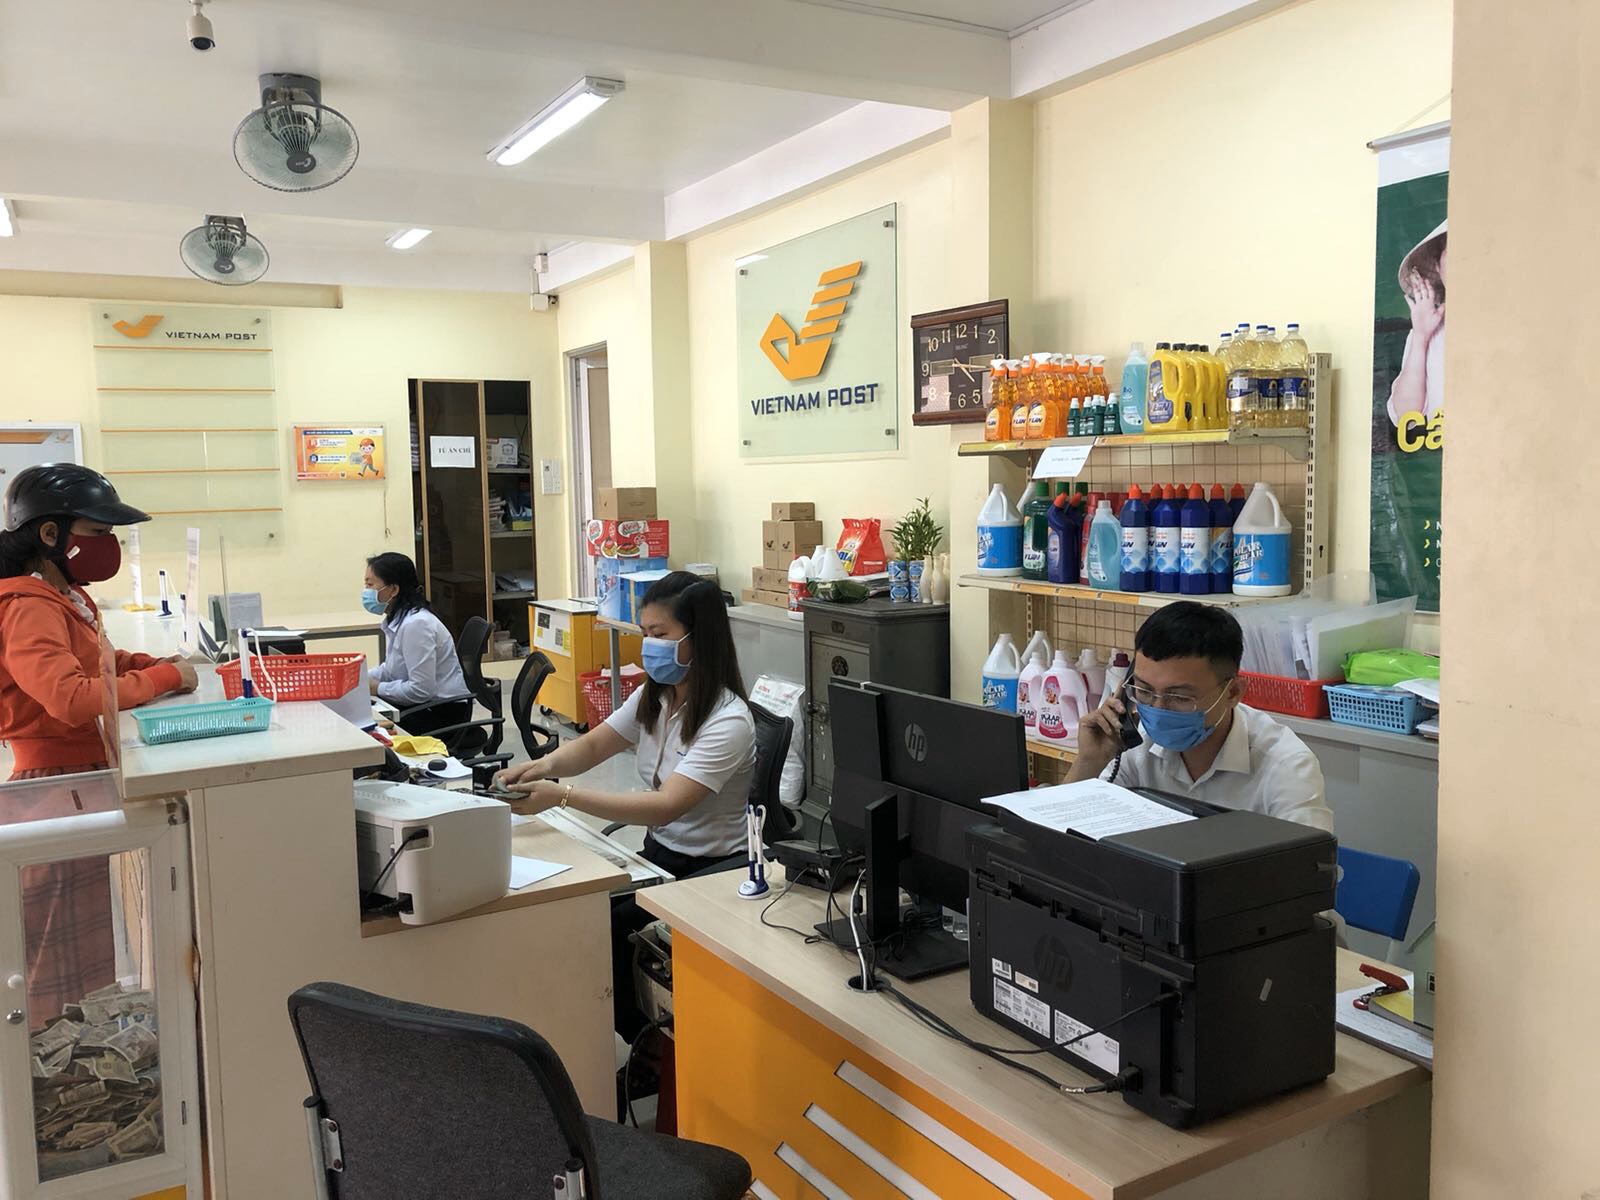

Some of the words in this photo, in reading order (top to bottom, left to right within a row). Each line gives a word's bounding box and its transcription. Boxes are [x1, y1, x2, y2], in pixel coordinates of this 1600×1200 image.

[165, 331, 220, 339] VIETNAM
[942, 329, 951, 343] 11
[956, 323, 967, 338] 12
[973, 324, 978, 339] 1
[987, 328, 996, 344] 2
[928, 337, 939, 352] 10
[921, 362, 930, 377] 9
[750, 390, 820, 416] VIETNAM
[827, 383, 879, 408] POST
[928, 387, 937, 401] 8
[957, 393, 966, 408] 6
[972, 389, 981, 404] 5
[908, 722, 926, 762] hp
